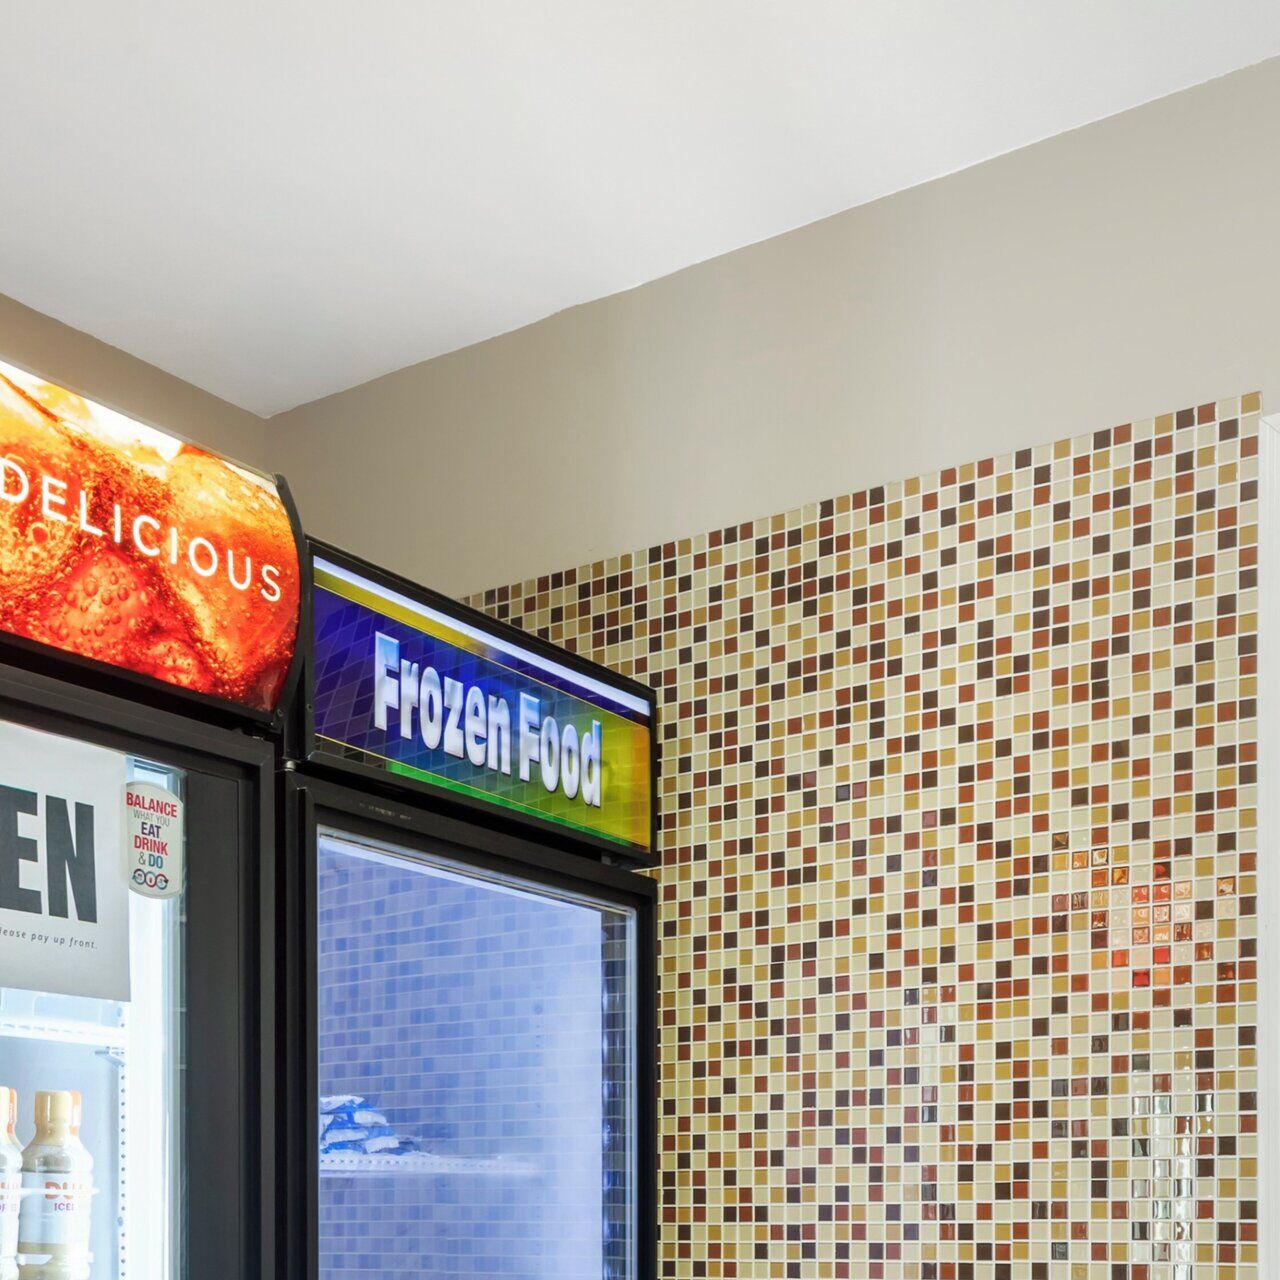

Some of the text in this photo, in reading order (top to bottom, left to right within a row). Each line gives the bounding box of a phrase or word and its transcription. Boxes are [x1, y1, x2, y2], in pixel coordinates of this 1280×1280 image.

[373, 630, 602, 808] Frozen Food
[126, 791, 177, 818] BALANCE
[133, 808, 170, 827] WHAT YOU
[141, 821, 161, 838] EAT
[134, 835, 168, 856] DRINK
[148, 853, 163, 869] DO
[31, 933, 49, 943] pay
[53, 937, 65, 946] up
